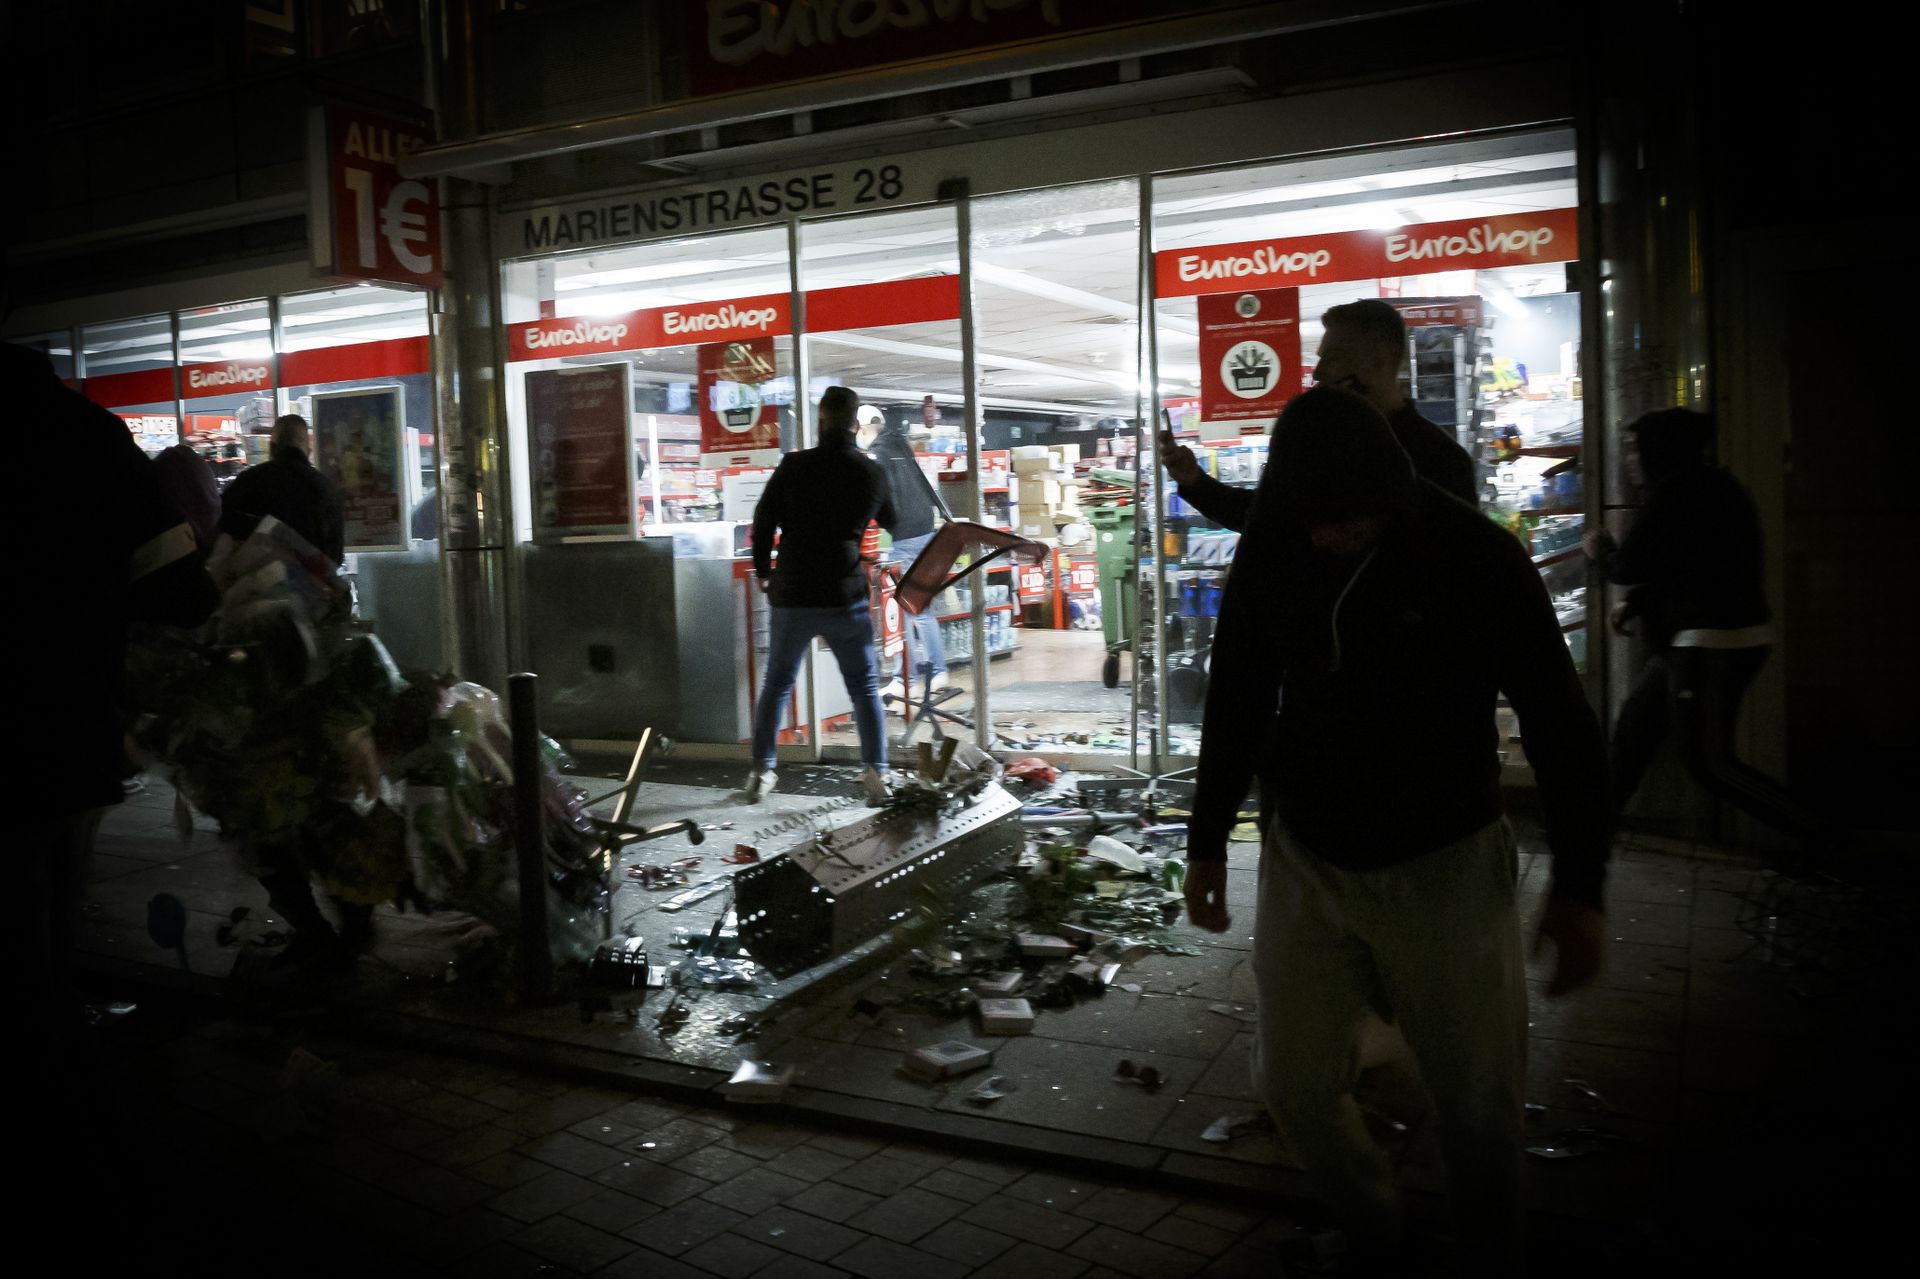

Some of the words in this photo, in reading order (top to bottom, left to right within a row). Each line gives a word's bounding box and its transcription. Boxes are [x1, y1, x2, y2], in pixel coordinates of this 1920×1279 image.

[707, 0, 1063, 64] Euro
[344, 166, 434, 274] 1€
[524, 172, 835, 249] MARIENSTRASSE
[853, 164, 903, 204] 28
[1384, 224, 1554, 263] EuroShop
[1178, 246, 1331, 282] EuroShop
[524, 319, 629, 350] EuroShop
[662, 304, 778, 335] EuroShop
[188, 363, 269, 389] EuroShop
